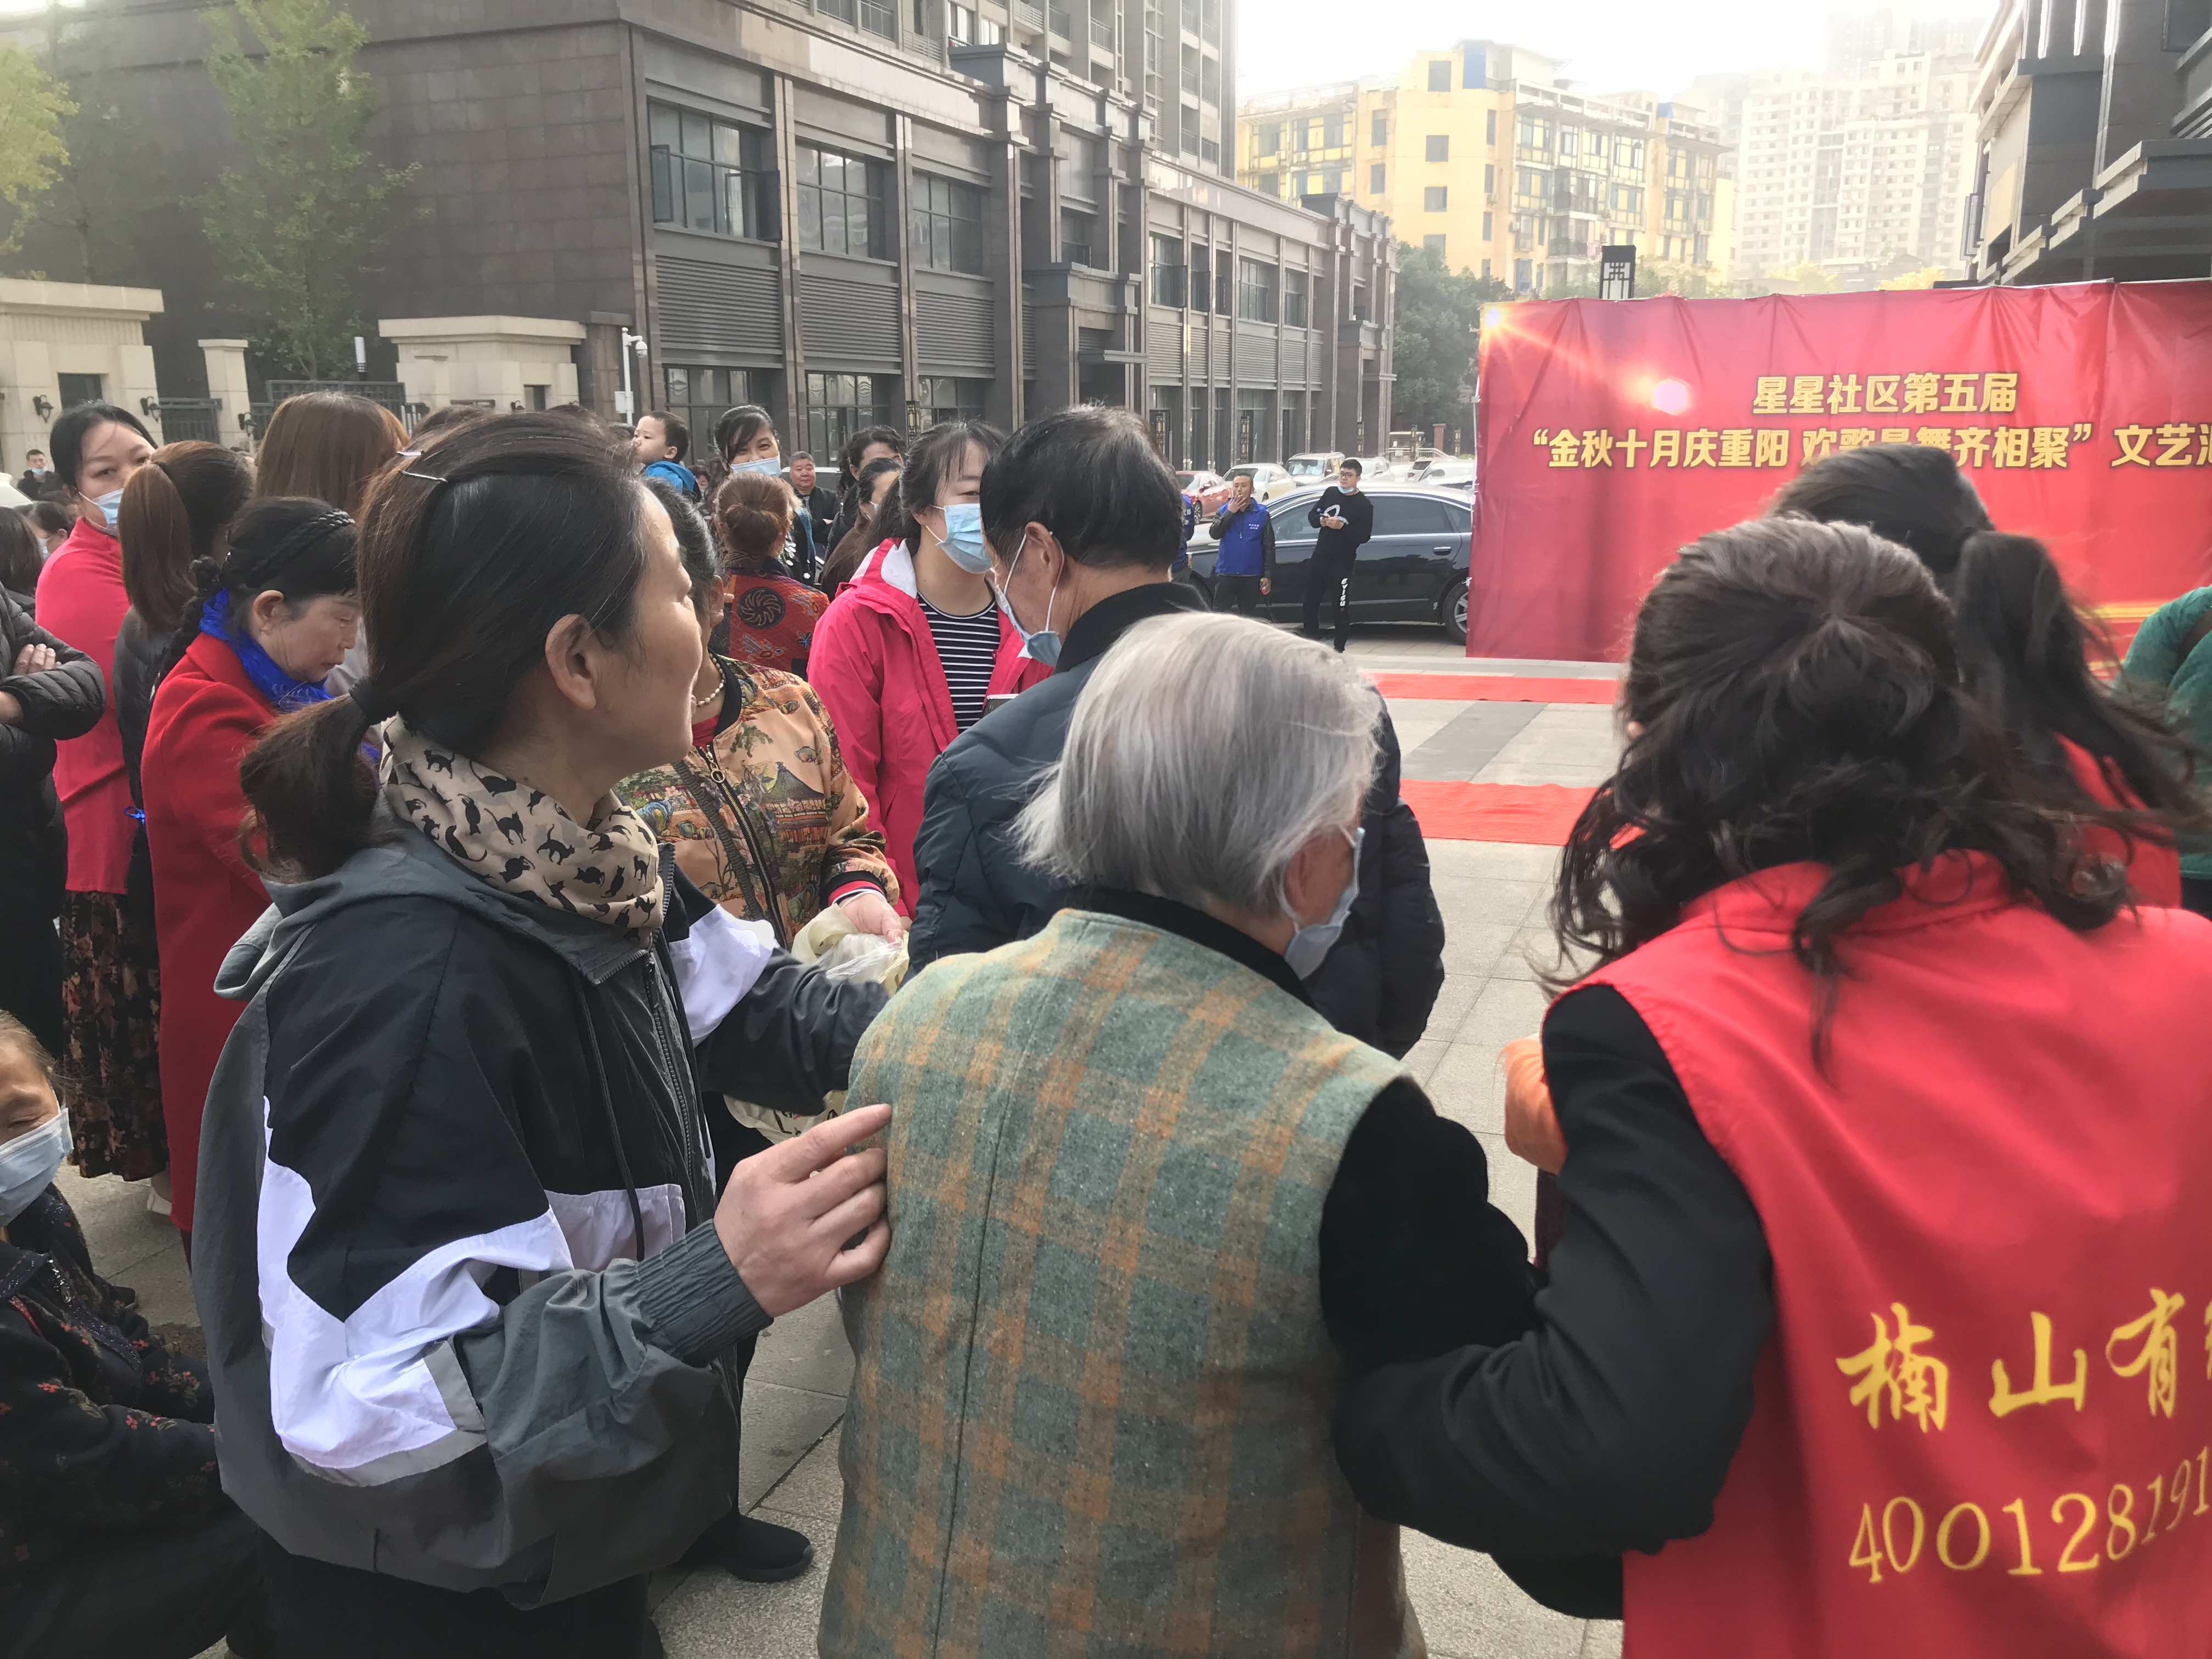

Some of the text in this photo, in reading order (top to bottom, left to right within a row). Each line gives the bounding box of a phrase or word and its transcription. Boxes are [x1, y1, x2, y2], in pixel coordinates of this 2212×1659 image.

[1753, 373, 2018, 414] 星星社区第五届
[1533, 428, 1790, 467] “金秋十月庆重阳
[1836, 1287, 2212, 1434] 楠山有
